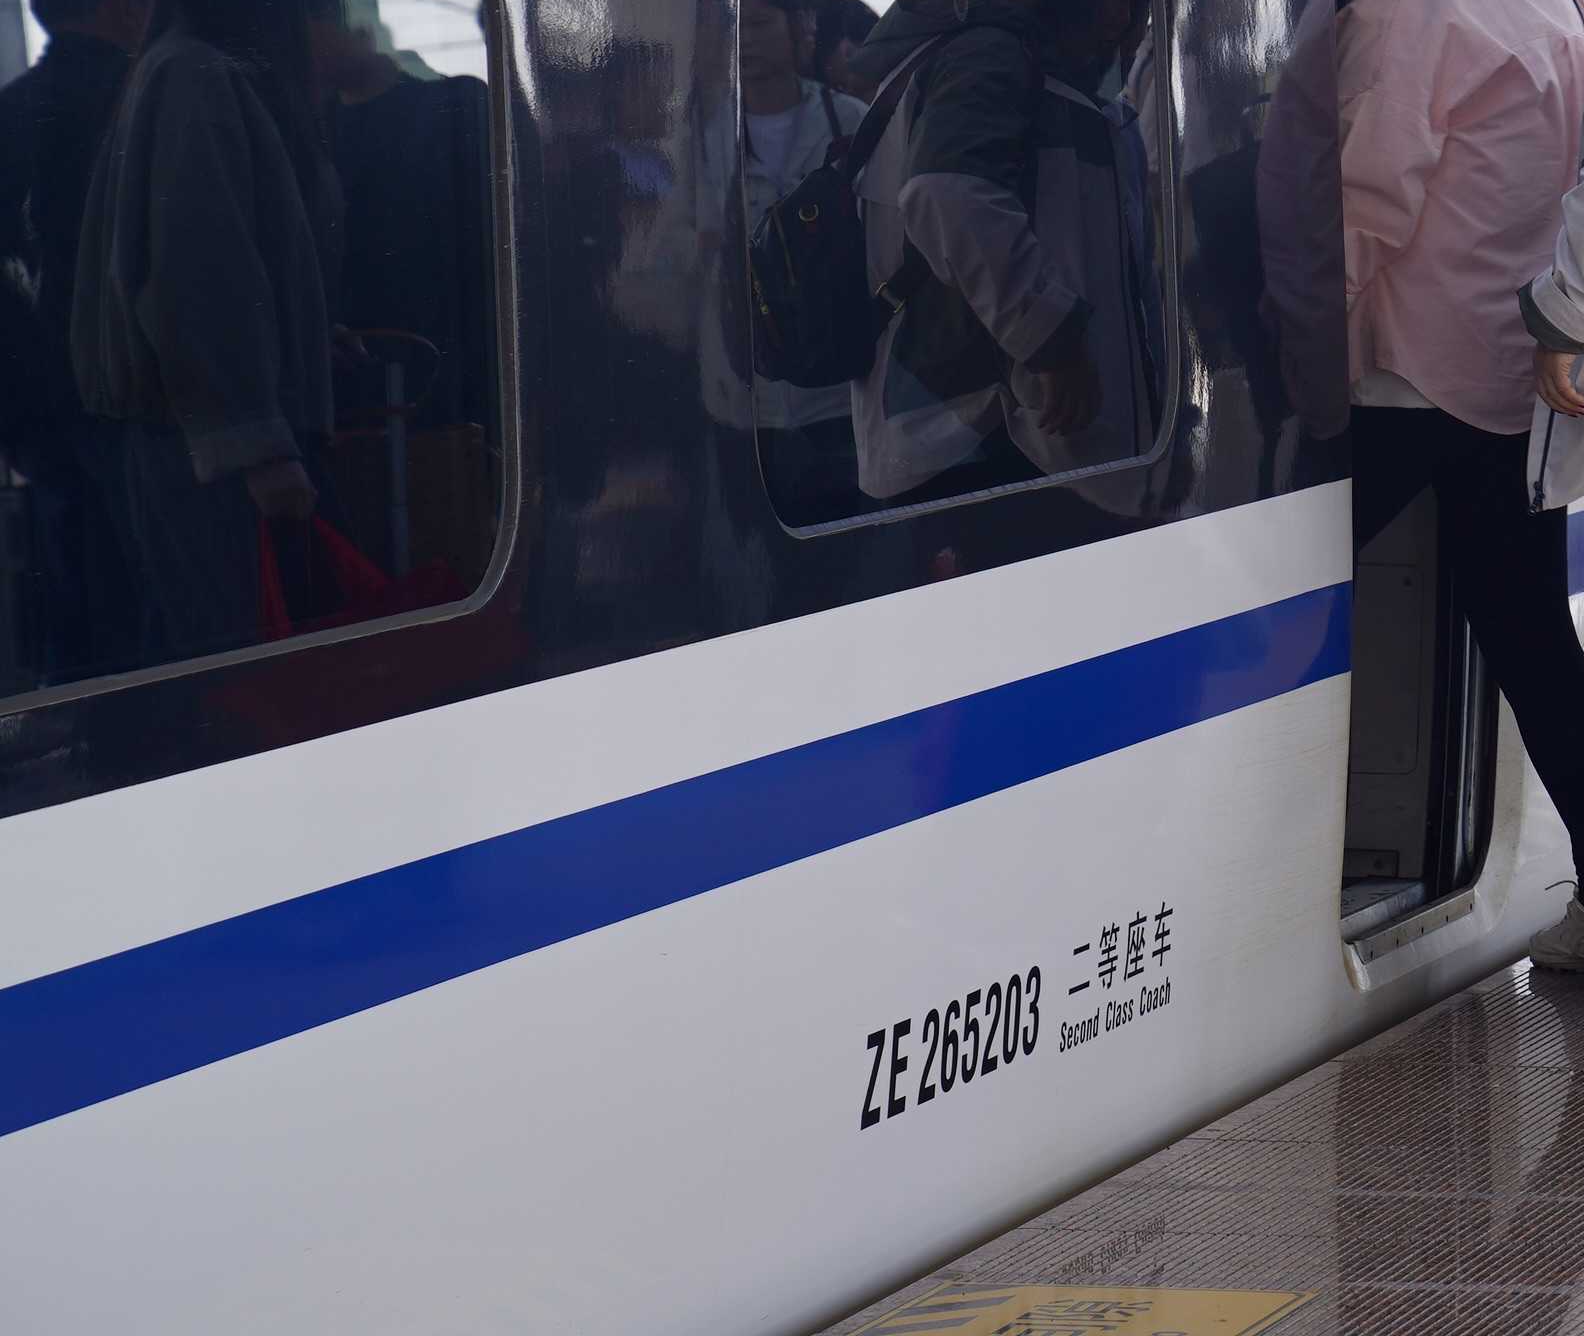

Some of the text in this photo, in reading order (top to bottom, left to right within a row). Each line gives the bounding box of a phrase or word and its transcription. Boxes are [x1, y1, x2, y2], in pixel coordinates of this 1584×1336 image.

[1068, 901, 1173, 995] 二等座车
[860, 965, 1041, 1132] ZE 265203
[1060, 976, 1171, 1053] Second Class Coach
